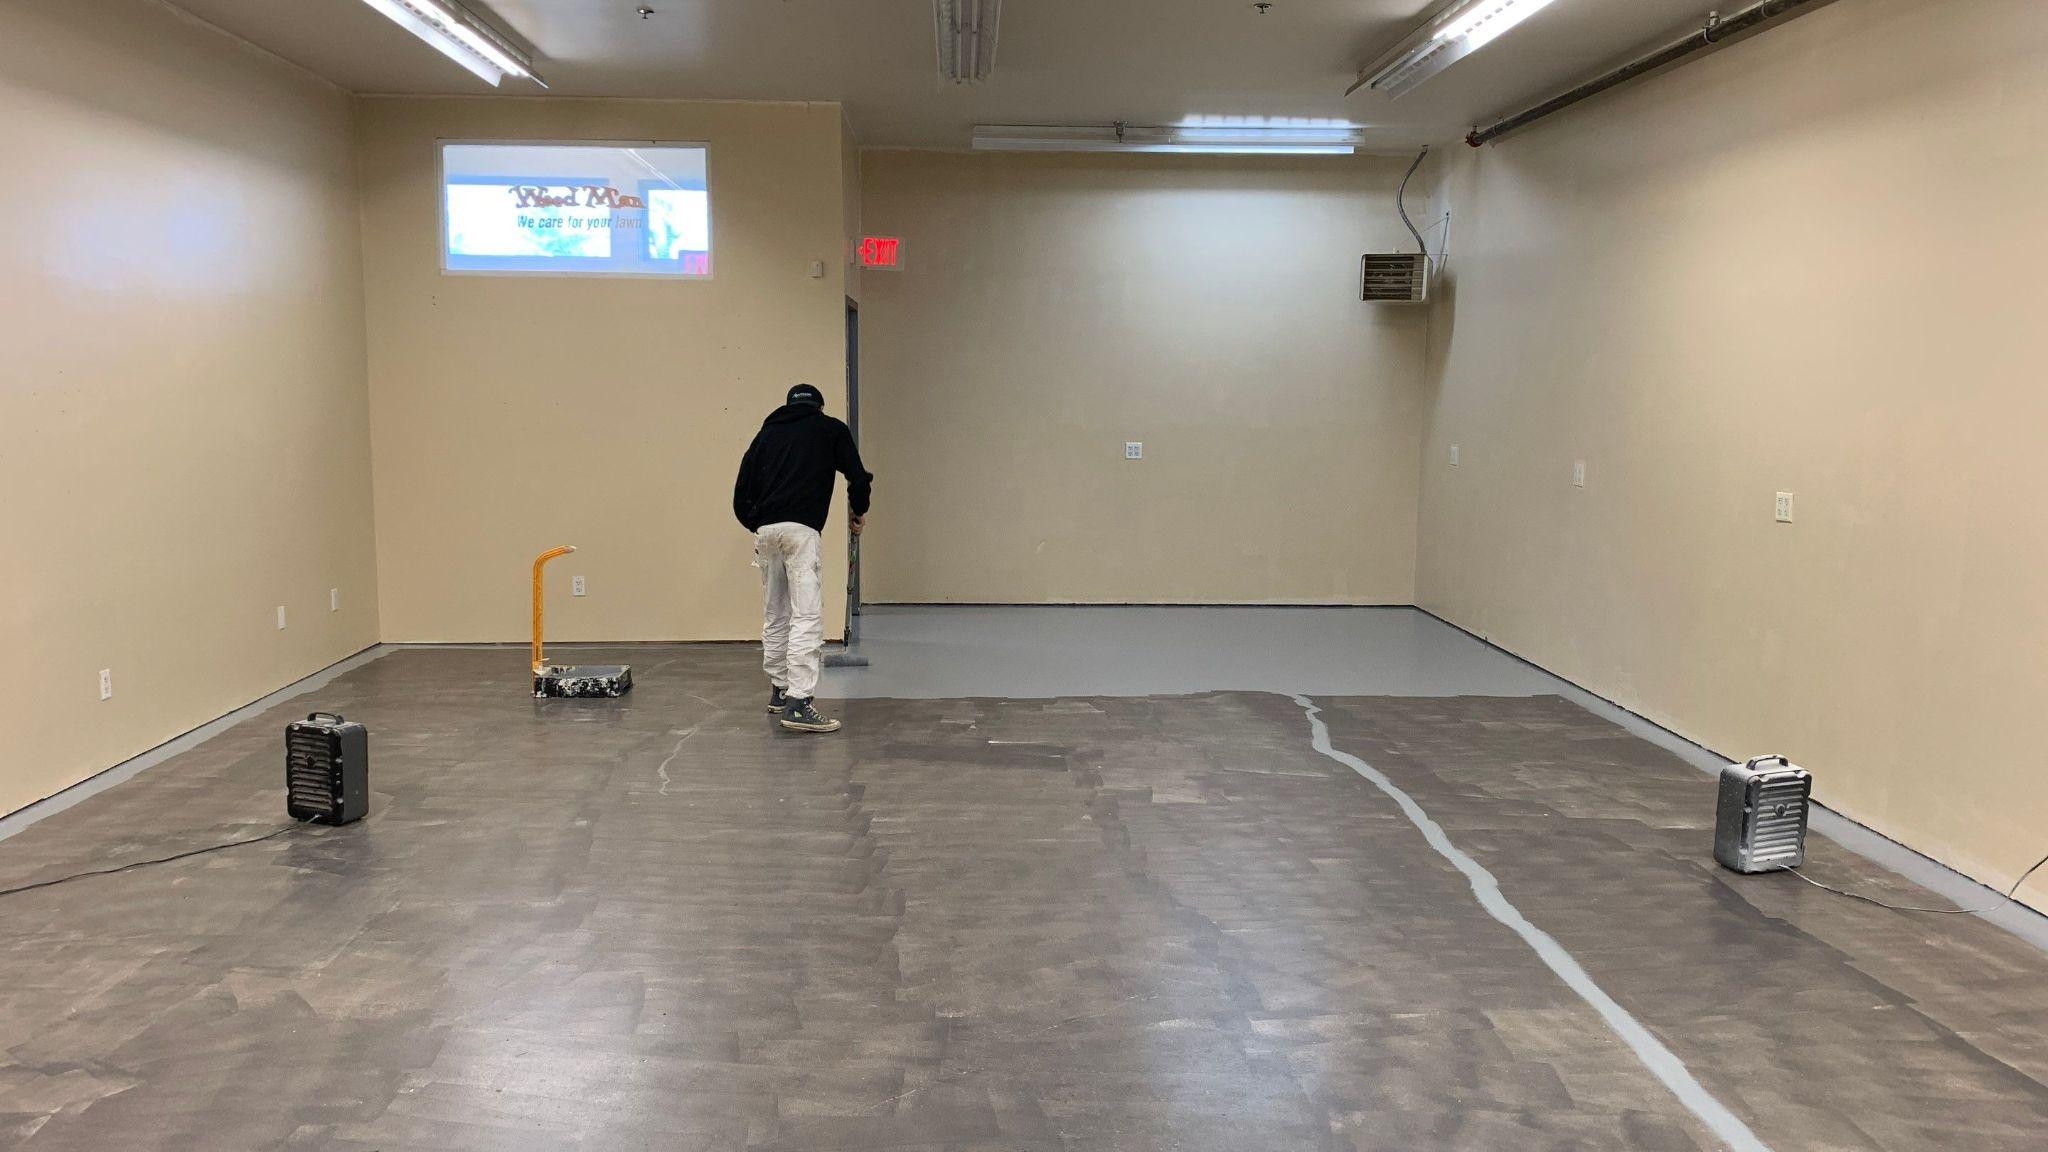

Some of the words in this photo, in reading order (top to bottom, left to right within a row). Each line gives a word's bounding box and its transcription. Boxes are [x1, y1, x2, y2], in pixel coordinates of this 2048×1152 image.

[518, 215, 535, 228] We
[538, 218, 563, 228] care
[568, 216, 584, 228] for
[587, 218, 611, 231] your
[615, 216, 642, 228] lawn
[864, 237, 899, 266] EXIT
